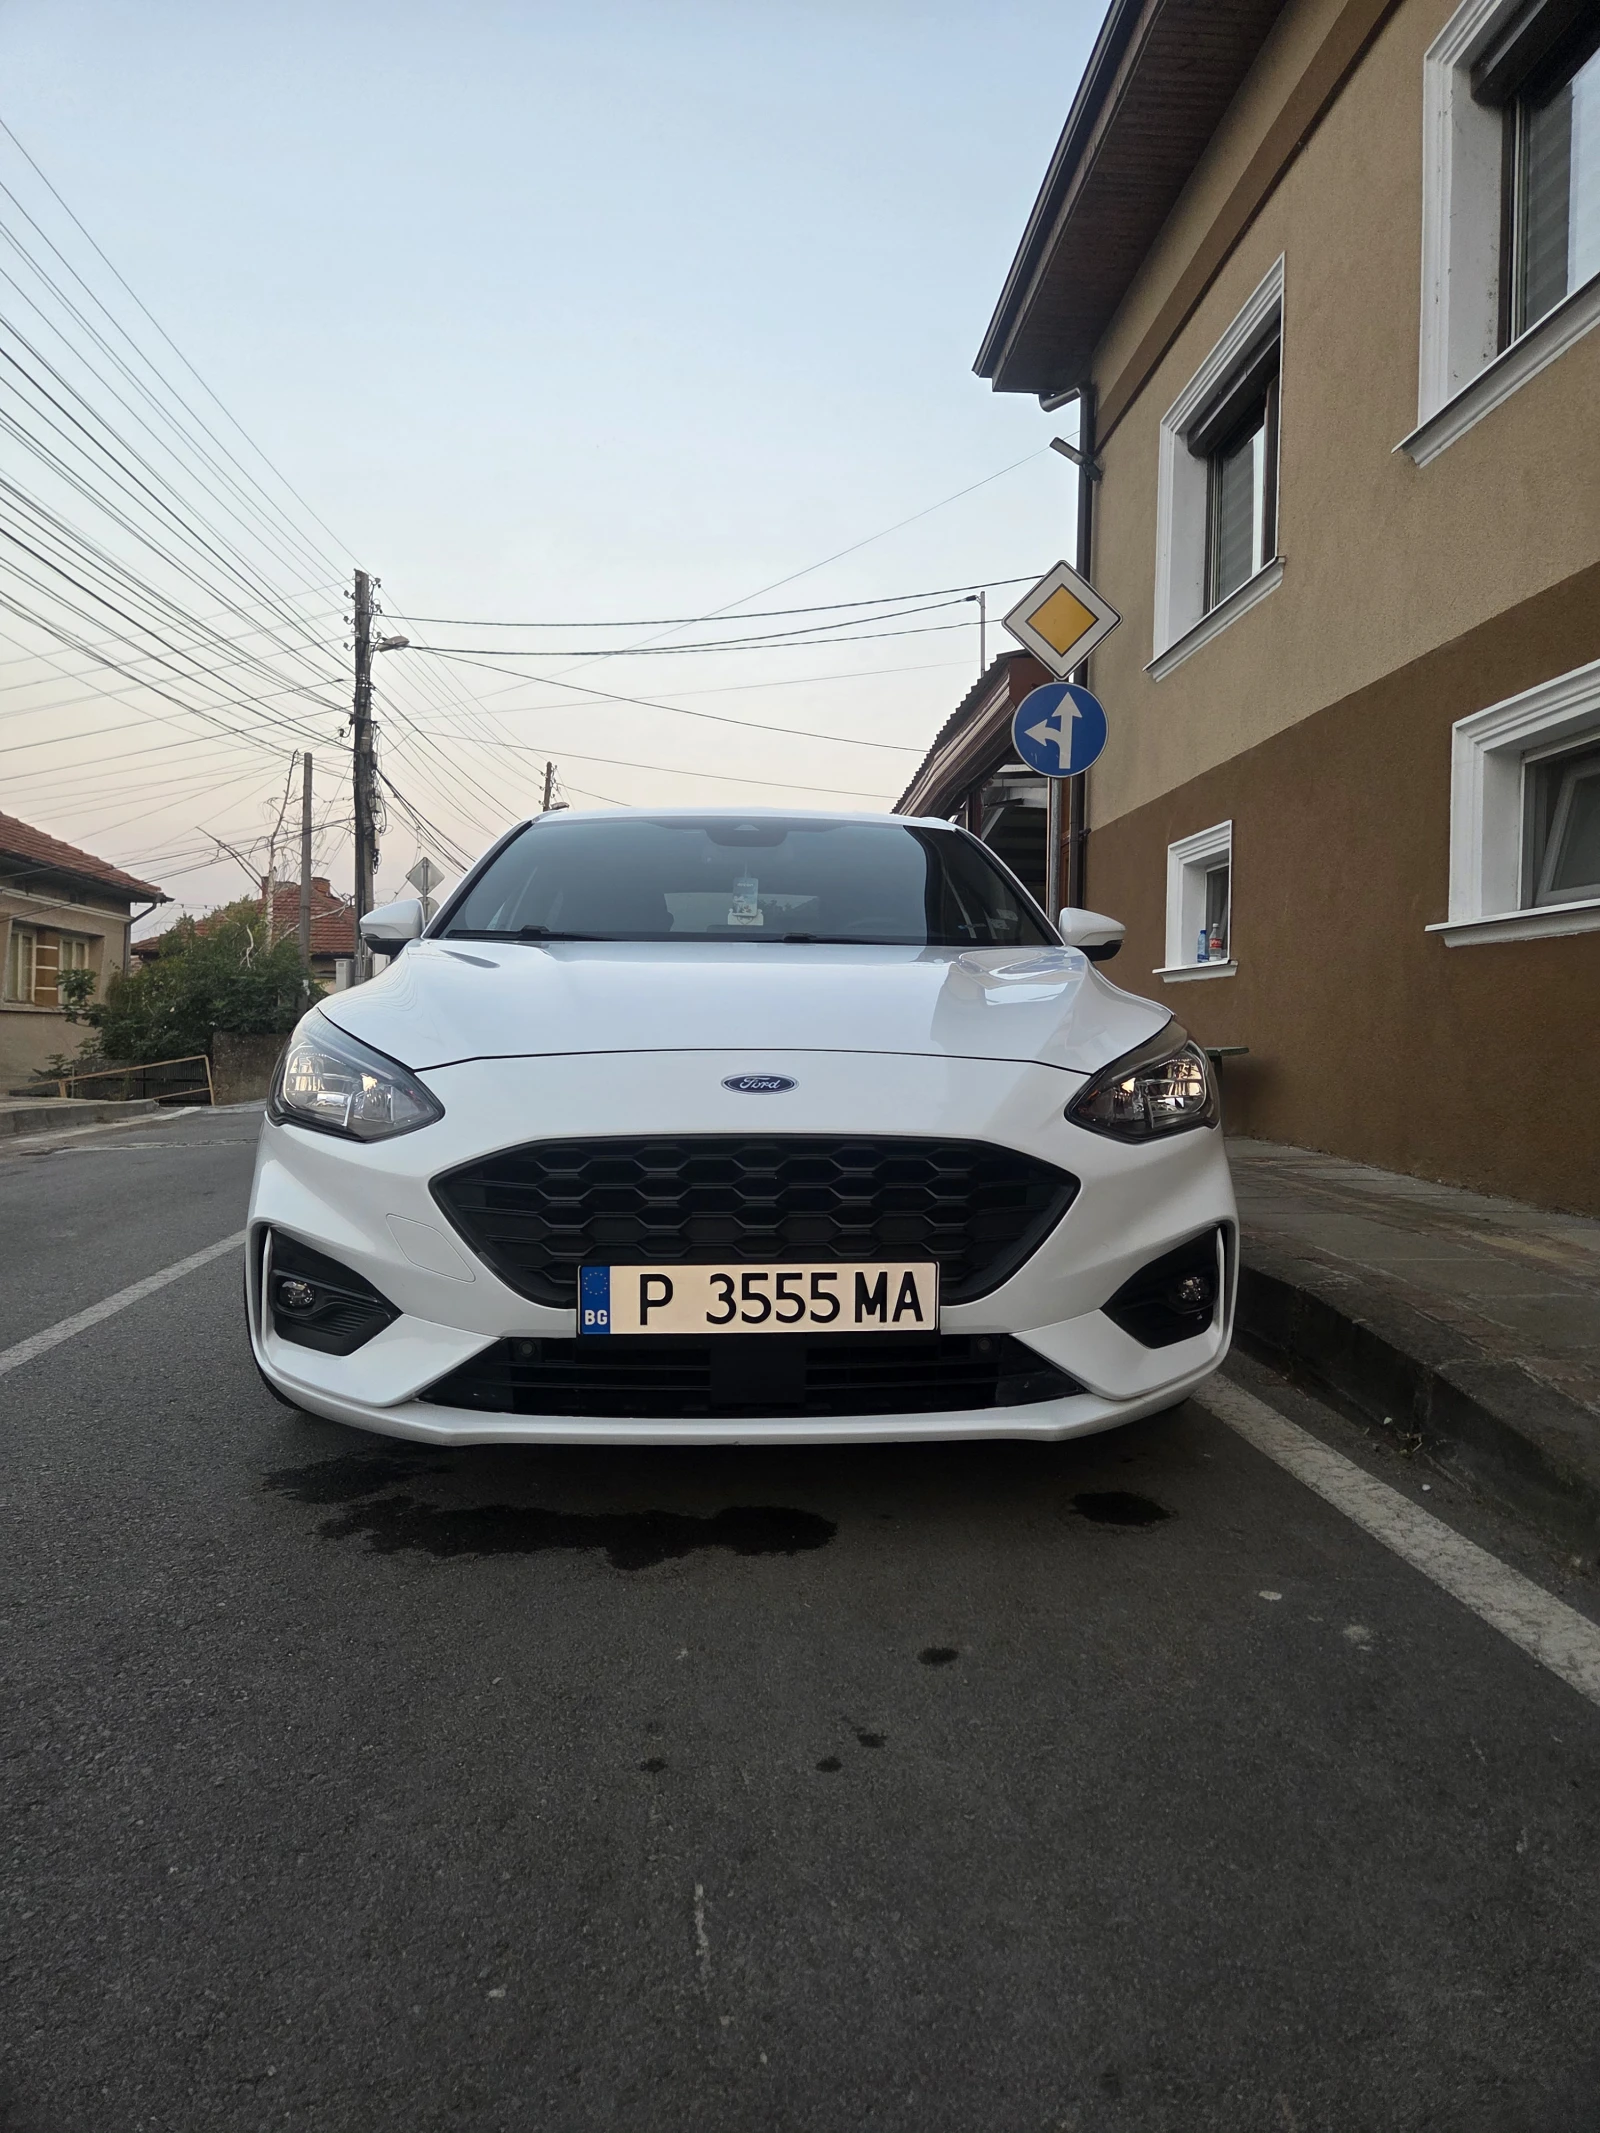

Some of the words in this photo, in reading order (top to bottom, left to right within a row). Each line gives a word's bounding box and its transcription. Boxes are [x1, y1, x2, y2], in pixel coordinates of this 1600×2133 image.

[739, 1077, 781, 1089] Ford
[640, 1273, 673, 1325] P
[706, 1273, 840, 1324] 3555
[855, 1271, 923, 1323] MA
[585, 1309, 607, 1325] BG
